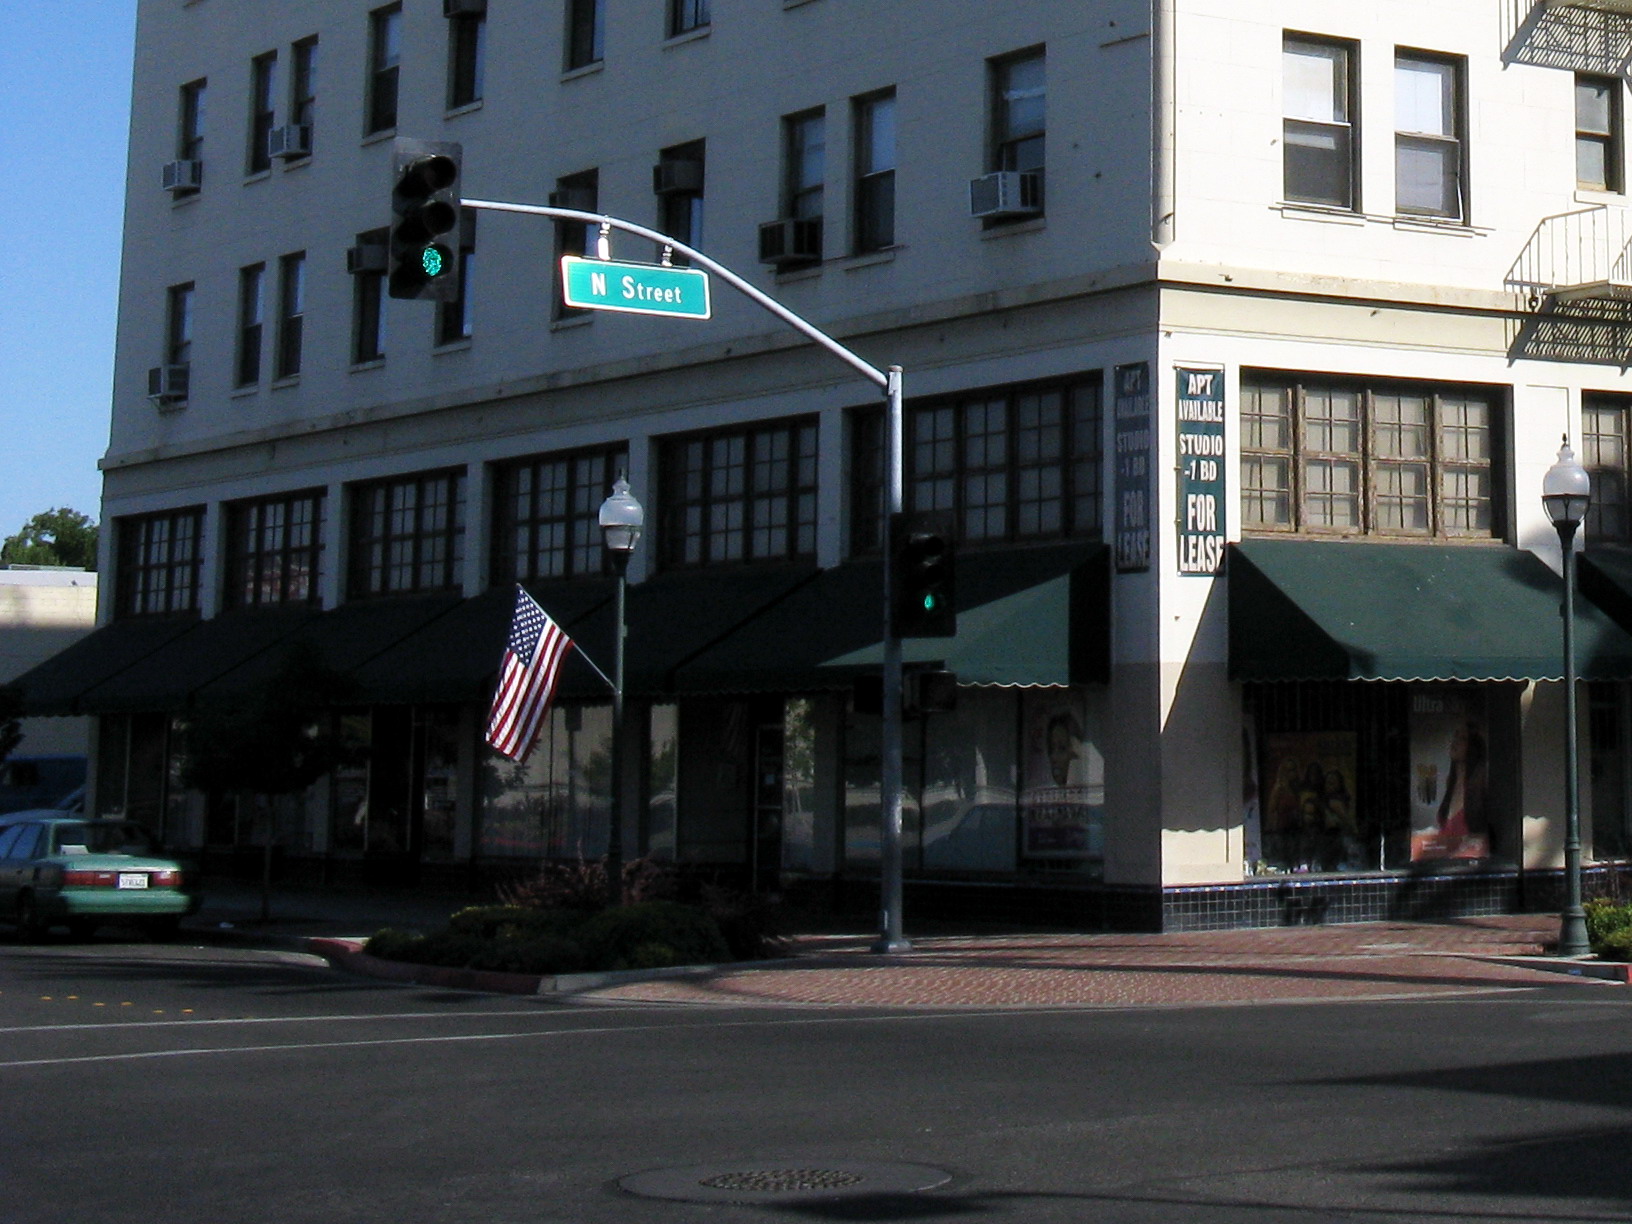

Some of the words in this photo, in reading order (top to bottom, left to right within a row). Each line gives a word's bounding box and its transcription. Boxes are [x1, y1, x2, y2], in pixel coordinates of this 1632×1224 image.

[591, 272, 607, 297] N
[622, 275, 683, 304] Street
[1124, 369, 1142, 392] APT
[1187, 373, 1214, 396] APT
[1178, 399, 1223, 422] AVAILABLE
[1116, 430, 1150, 453] STUDIO
[1179, 433, 1223, 456] STUDIO
[1184, 459, 1197, 480] -1
[1200, 460, 1217, 481] BD
[1123, 490, 1143, 527] FOR
[1187, 493, 1216, 531] FOR
[1117, 531, 1150, 568] LEASE
[1180, 534, 1224, 573] LEASE
